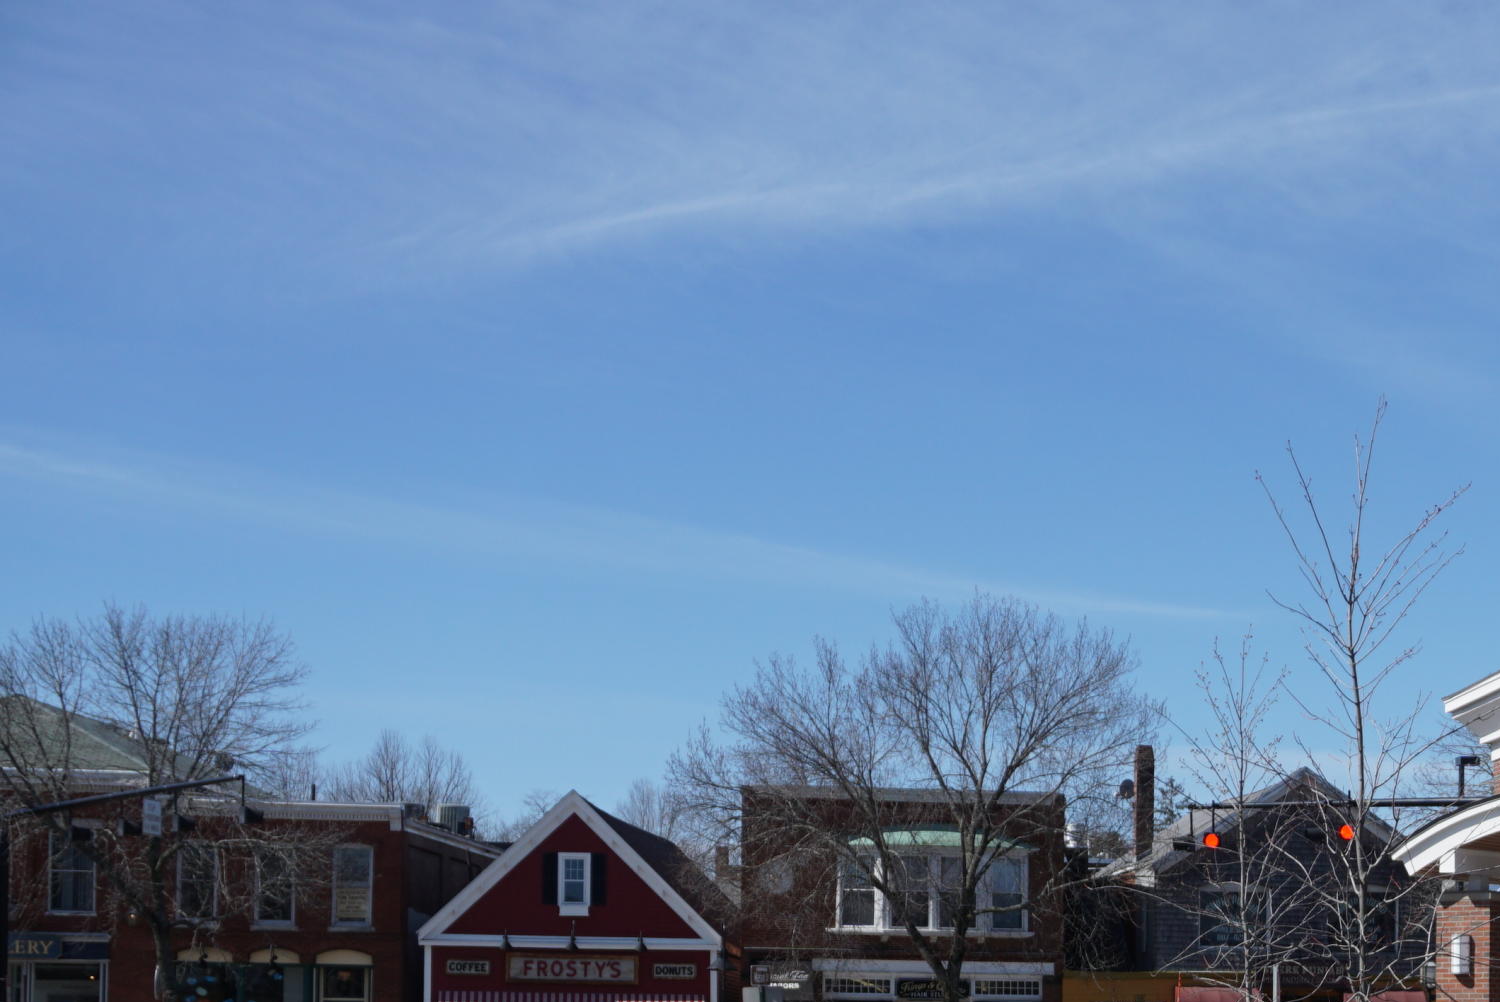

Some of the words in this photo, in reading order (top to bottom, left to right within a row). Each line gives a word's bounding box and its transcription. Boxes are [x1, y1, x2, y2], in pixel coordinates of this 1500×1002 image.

[448, 962, 488, 973] COFFEE
[523, 959, 621, 978] FROSTY'S
[655, 965, 694, 975] DONUTS
